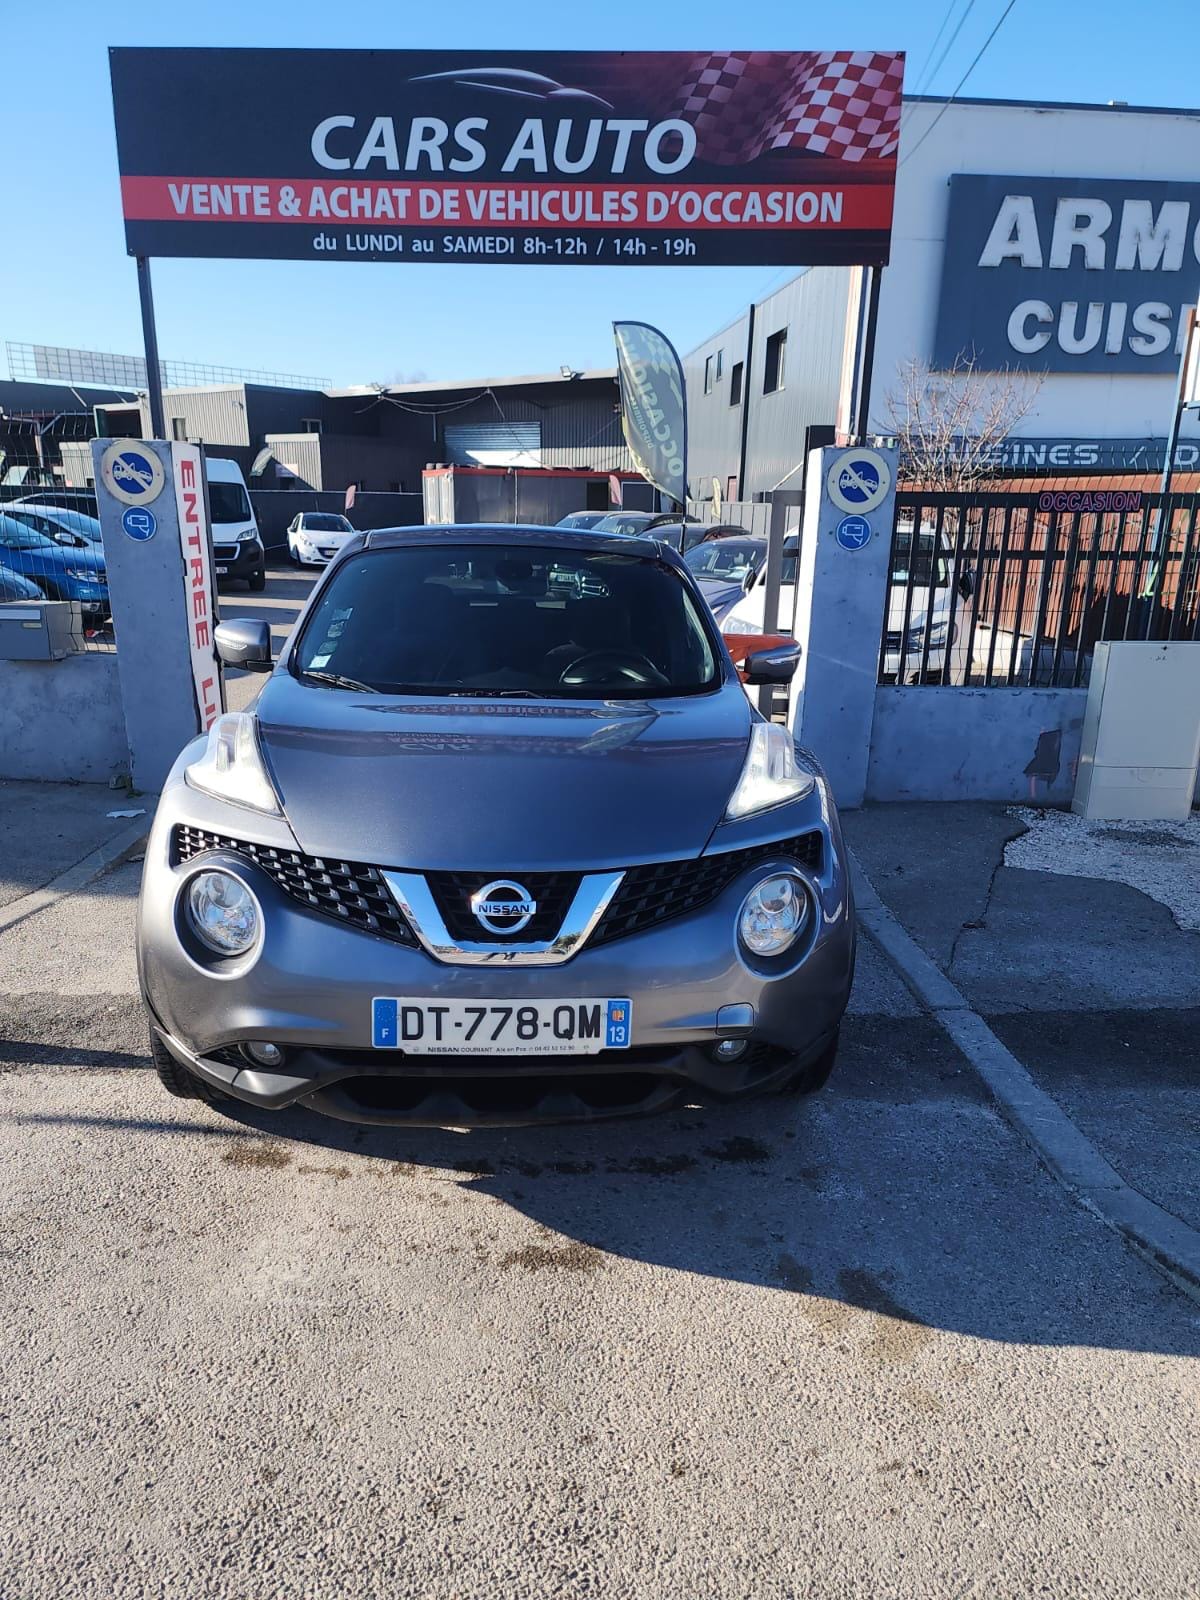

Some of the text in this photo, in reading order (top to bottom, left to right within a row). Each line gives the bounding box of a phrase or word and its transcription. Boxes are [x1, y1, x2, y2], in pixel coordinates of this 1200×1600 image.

[310, 115, 698, 175] CARS AUTO
[168, 183, 844, 223] VENTE & ACHAT DE VEHICULES D'OCCASION
[312, 233, 337, 251] du
[346, 234, 403, 252] LUNDI
[411, 239, 434, 253] au
[443, 236, 515, 254] SAMEDI
[523, 236, 588, 255] 8h-12h
[978, 195, 1200, 272] ARM
[1038, 491, 1142, 512] OCCASION
[181, 460, 210, 650] ENTREE
[478, 904, 531, 914] NISSAN
[382, 1028, 389, 1038] F
[401, 1004, 600, 1041] DT-778-QM
[610, 1026, 625, 1042] 13
